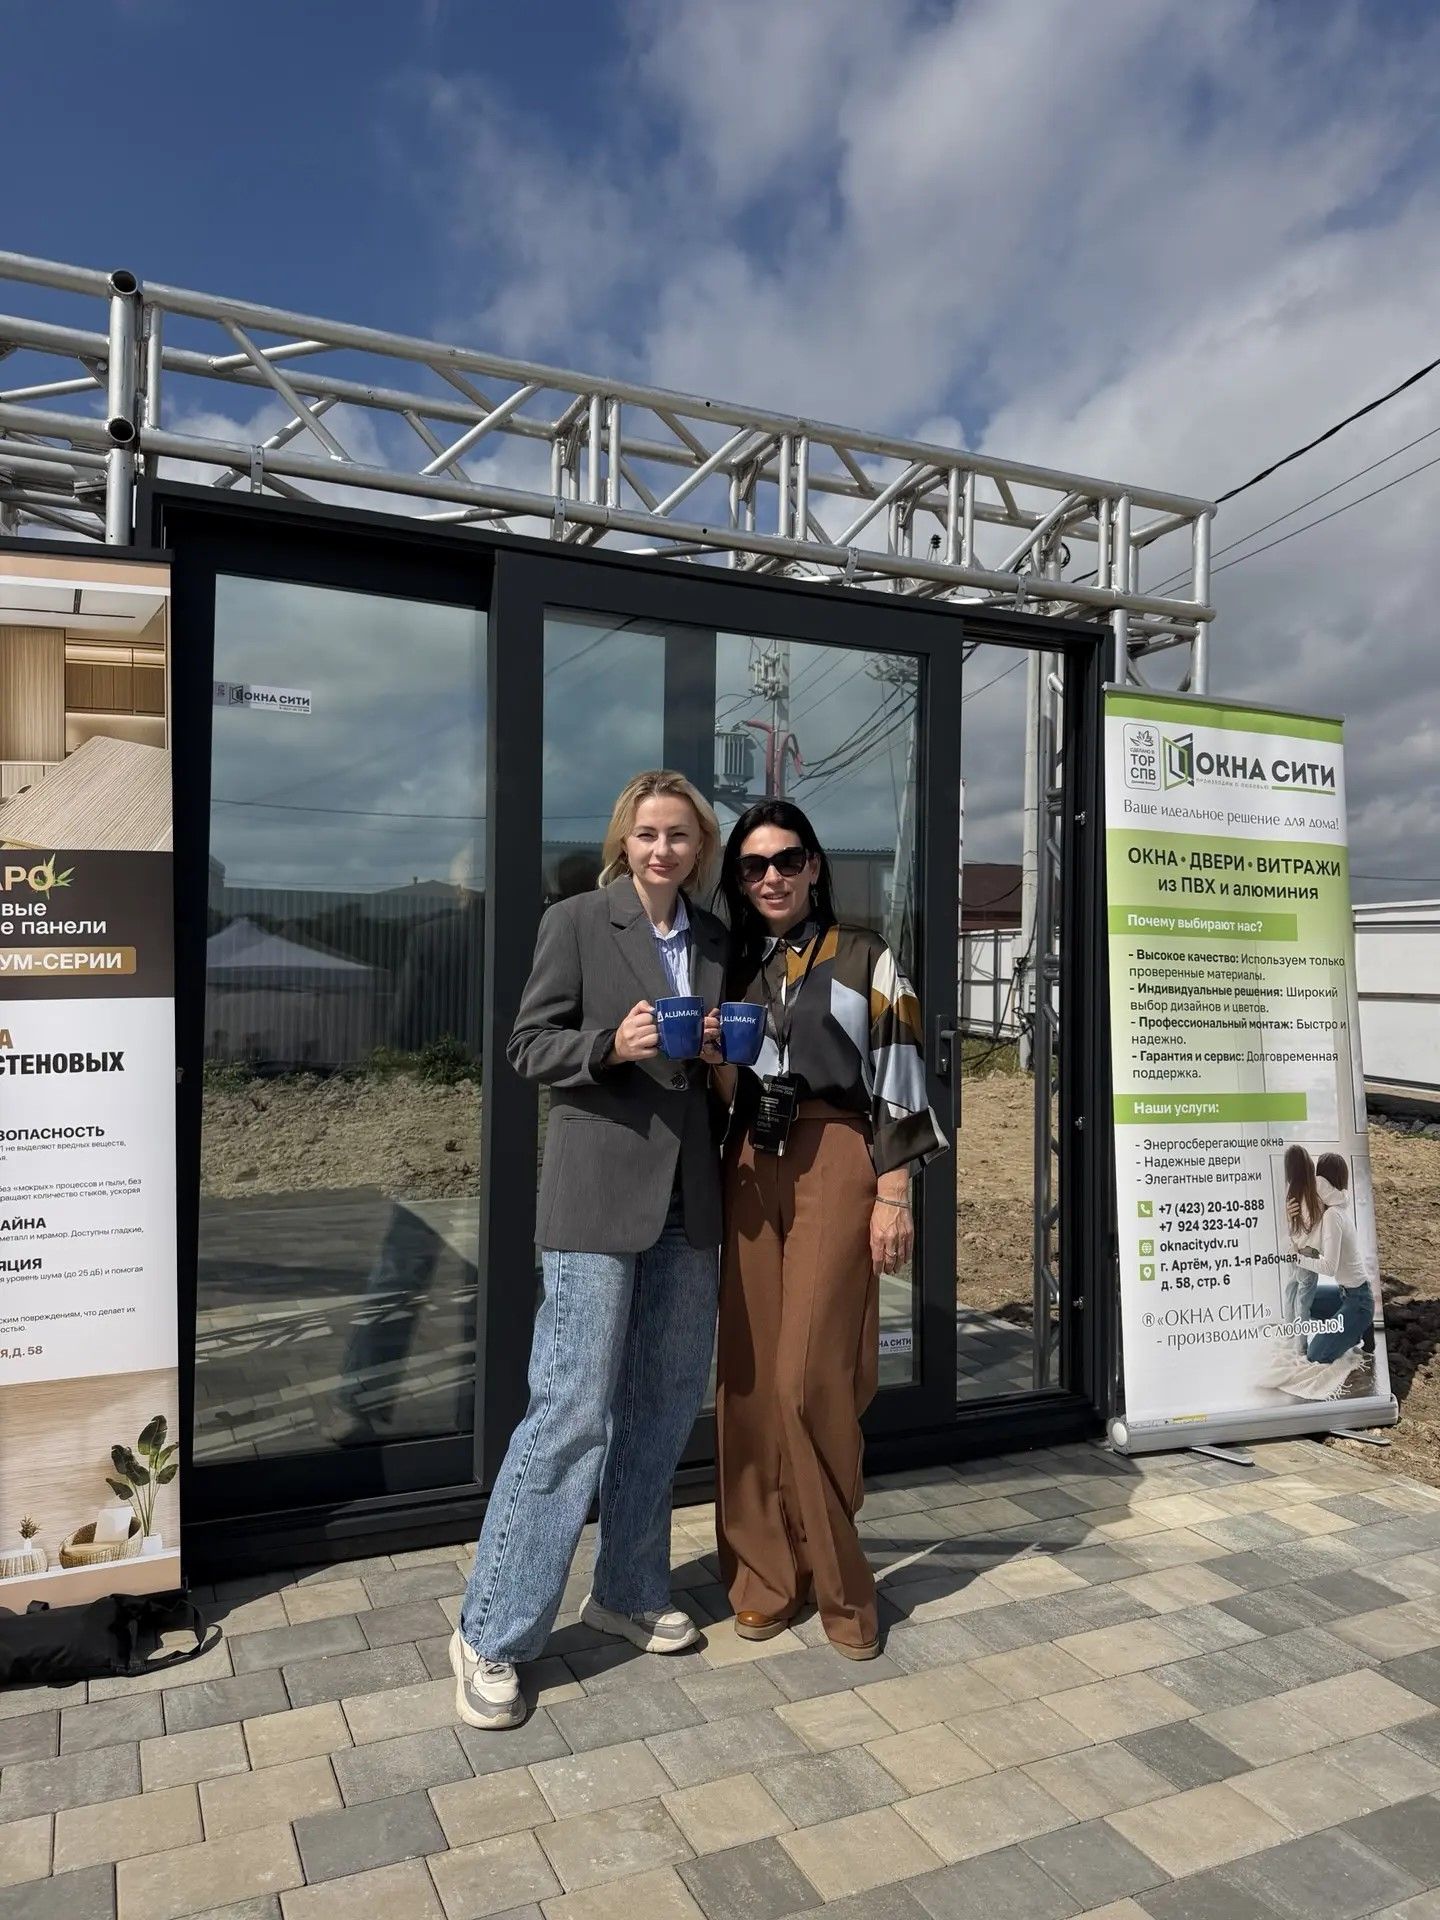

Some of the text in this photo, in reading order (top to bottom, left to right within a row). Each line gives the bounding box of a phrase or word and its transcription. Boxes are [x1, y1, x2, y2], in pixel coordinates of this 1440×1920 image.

[244, 692, 277, 703] ОКНА
[279, 695, 310, 705] СИТИ
[1131, 754, 1155, 766] ТОР
[1131, 768, 1156, 780] СПВ
[1196, 752, 1335, 787] ОКНА СИТИ
[1124, 800, 1339, 830] Ваше идеальное решение для дома!
[1128, 848, 1341, 876] ОКНА ДВЕРИ ВИТРАЖИ
[0, 866, 54, 891] РО
[1159, 877, 1319, 899] из ПВХ и алюминия
[22, 920, 106, 934] панели
[1128, 914, 1263, 932] Почему выбирают нас?
[1137, 950, 1185, 961] Высокое
[1188, 954, 1239, 964] качество:
[1241, 954, 1306, 967] Используем
[1309, 957, 1345, 966] только
[1130, 967, 1265, 981] проверенные материалы.
[1138, 983, 1232, 997] Индивидуальные
[1234, 987, 1282, 998] решения:
[1286, 986, 1337, 998] Широкий
[1131, 999, 1269, 1014] выбор дизайнов и цветов.
[665, 1010, 699, 1018] ALUMARK
[724, 1016, 756, 1024] ALUMARK
[1139, 1017, 1247, 1030] Профессиональный
[1249, 1020, 1293, 1030] монтаж:
[1297, 1019, 1338, 1031] Быстро
[1132, 1035, 1186, 1045] надежно.
[1140, 1052, 1192, 1064] Гарантия
[1195, 1053, 1201, 1061] и
[1204, 1053, 1244, 1064] сервис:
[1247, 1052, 1339, 1064] Долговременная
[1133, 1069, 1201, 1081] поддержка.
[1134, 1102, 1219, 1116] Наши услуги:
[17, 1143, 55, 1151] выделяют
[57, 1142, 90, 1150] вредных
[92, 1140, 126, 1148] веществ,
[1144, 1138, 1258, 1152] Энергосберегающие
[1260, 1137, 1284, 1147] окна
[1145, 1157, 1205, 1168] Надежные
[1208, 1156, 1240, 1167] двери
[1145, 1173, 1213, 1184] Элегантные
[1216, 1172, 1261, 1184] витражи
[14, 1184, 54, 1192] «мокрых»
[56, 1181, 97, 1189] процессов
[33, 1191, 78, 1199] количество
[110, 1188, 140, 1196] ускоряя
[1159, 1200, 1264, 1216] +7 (423) 20-10-888
[0, 1217, 46, 1230] АЙНА
[1160, 1217, 1258, 1232] +7 924 323-14-07
[36, 1232, 69, 1240] мрамор.
[71, 1230, 109, 1238] Доступны
[1160, 1238, 1238, 1252] oknacitydv.ru
[1161, 1253, 1301, 1273] г. Артём, ул. 1-я Рабочая,
[6, 1275, 38, 1284] уровень
[64, 1271, 76, 1279] (до
[111, 1267, 143, 1275] помогая
[1161, 1275, 1230, 1291] д. 58, стр. 6
[21, 1312, 82, 1322] повреждениям,
[98, 1308, 124, 1316] делает
[1219, 1304, 1271, 1321] СИТИ»
[1168, 1328, 1258, 1350] производим
[1275, 1314, 1344, 1337] любовью!
[890, 1338, 911, 1346] СИТИ
[28, 1346, 43, 1355] 58
